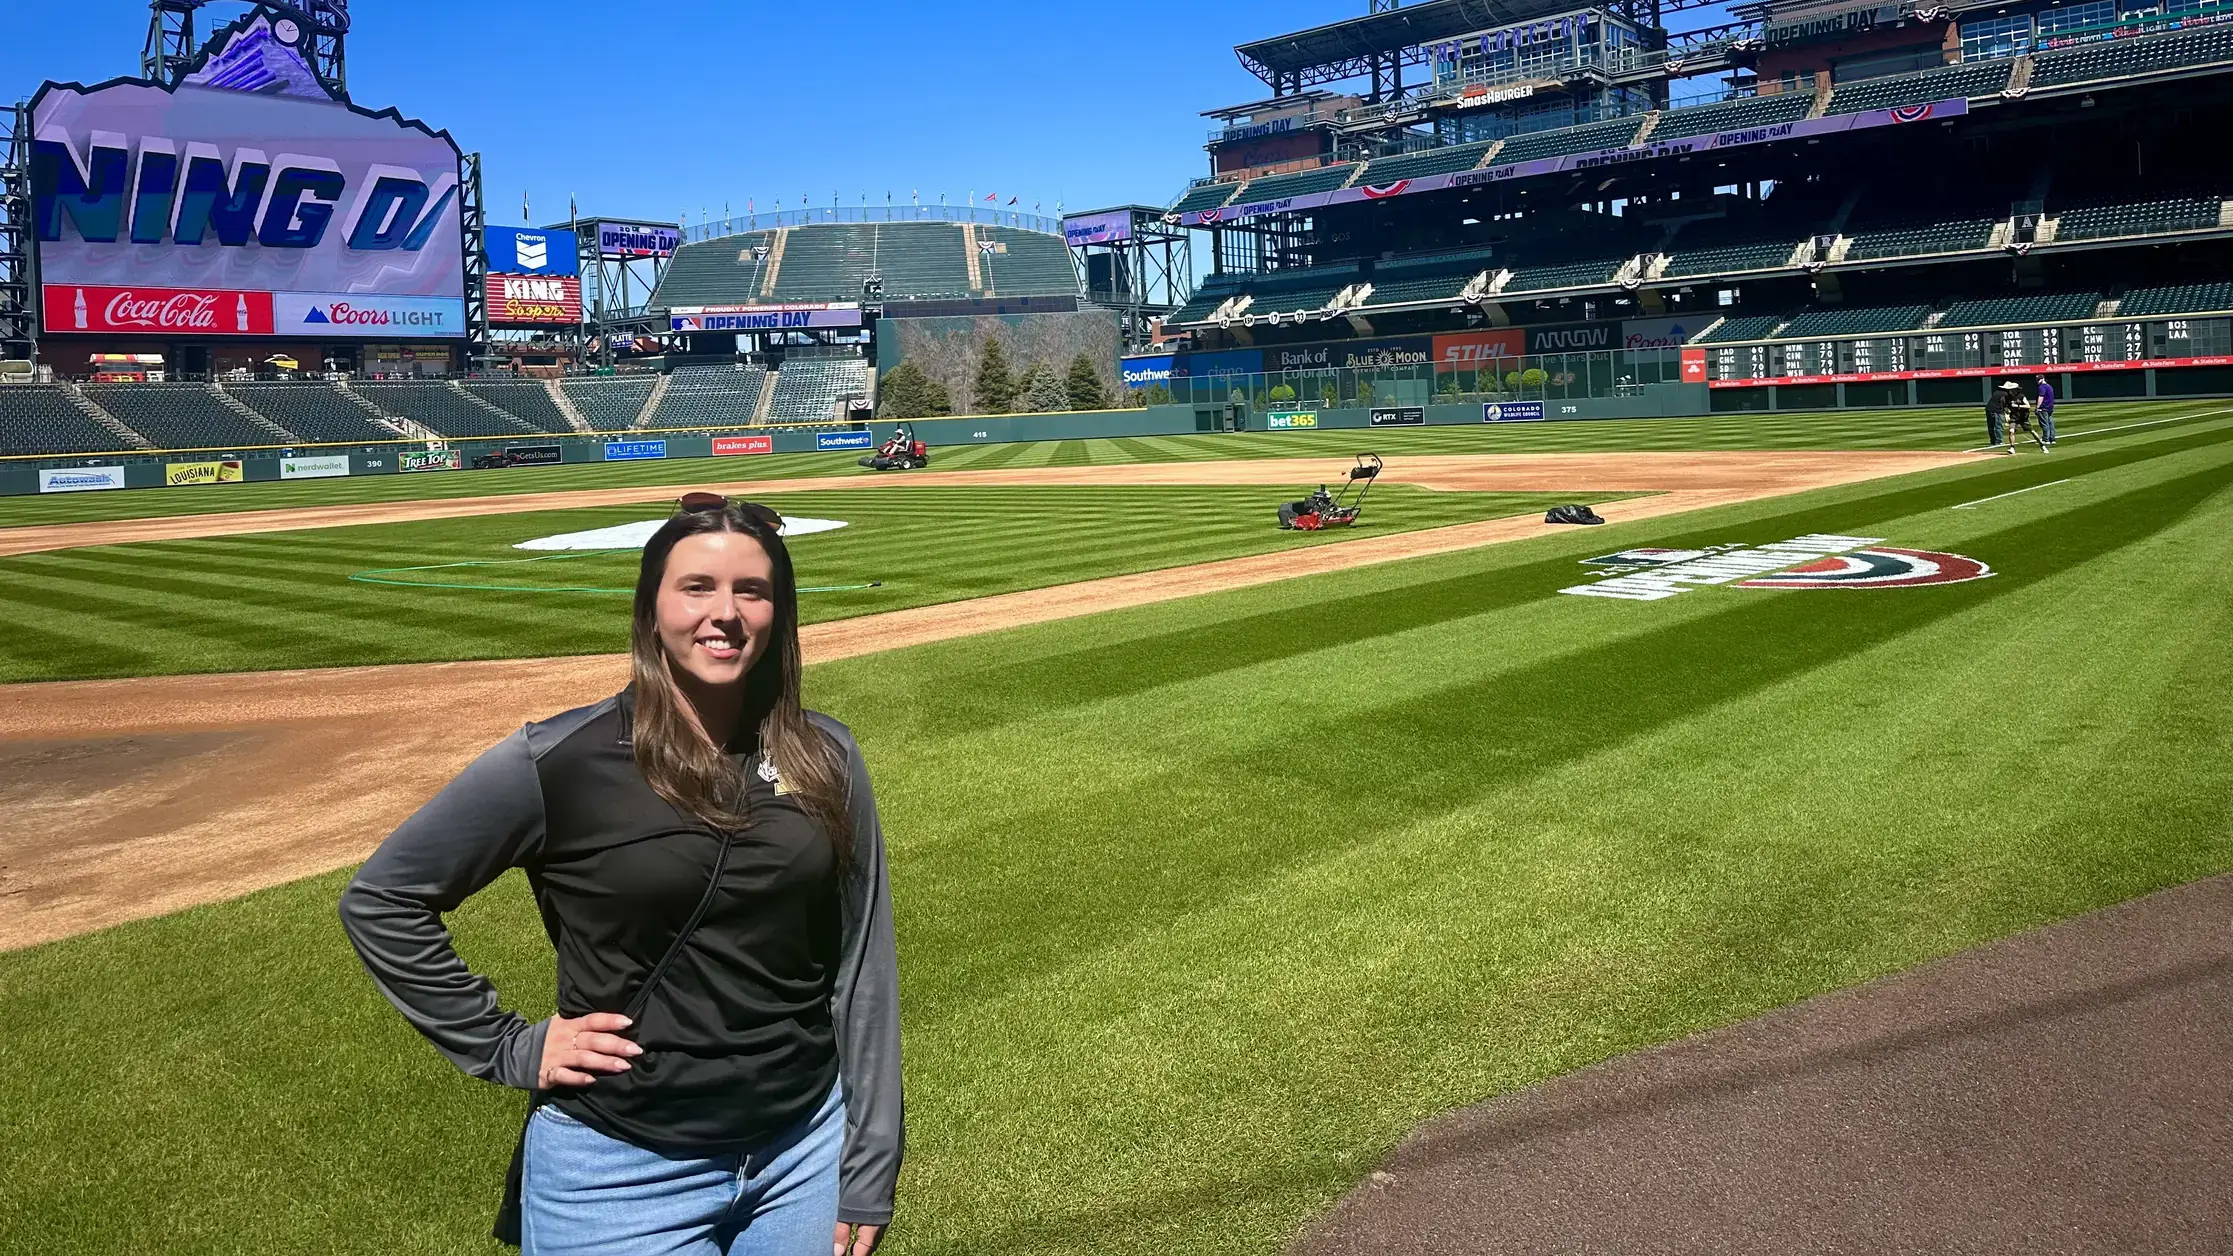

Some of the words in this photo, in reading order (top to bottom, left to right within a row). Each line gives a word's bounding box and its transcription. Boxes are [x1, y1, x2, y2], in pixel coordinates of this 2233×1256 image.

[1768, 16, 1843, 41] OPENING
[1847, 8, 1879, 29] DAY
[1480, 13, 1588, 54] ROOFTOP
[1224, 122, 1269, 141] OPENING
[1272, 118, 1291, 131] DAY
[1720, 129, 1766, 145] OPENING
[1456, 171, 1496, 186] OPENING
[1244, 202, 1274, 215] OPENING
[2021, 216, 2033, 228] A
[516, 233, 546, 241] Chevron
[1068, 228, 1092, 238] OPENING
[603, 232, 656, 250] OPENING
[658, 236, 680, 250] DAY
[504, 280, 564, 300] KING
[105, 292, 219, 327] Coca-Cola
[329, 303, 390, 325] Coors
[393, 311, 443, 326] LIGHT
[705, 313, 777, 329] OPENING
[782, 312, 811, 327] DAY
[2168, 320, 2187, 329] BOS
[612, 334, 632, 343] PLATTE
[1535, 328, 1608, 349] ARROW
[2003, 331, 2020, 339] TOR
[2084, 334, 2103, 343] CHW
[2169, 330, 2188, 339] LAA
[1626, 333, 1678, 351] Coors
[1927, 336, 1943, 344] SEA
[2003, 340, 2021, 348] NYY
[1445, 343, 1512, 360] STIHL
[1720, 348, 1734, 356] LAD
[1786, 344, 1802, 352] NYM
[1928, 344, 1944, 352] MIL
[2085, 345, 2102, 353] HOU
[1281, 349, 1312, 365] Bank
[1315, 348, 1328, 363] of
[1590, 352, 1608, 361] Out
[2003, 350, 2022, 358] OAK
[2085, 354, 2100, 362] TEX
[1346, 353, 1373, 367] BLUE
[1395, 352, 1427, 363] MOON
[1720, 356, 1735, 364] CHC
[2004, 359, 2019, 367] DET
[1123, 367, 1179, 382] Southwest
[1207, 365, 1244, 382] cigna
[1283, 362, 1340, 380] Colorado
[1858, 366, 1871, 374] PIT
[1720, 373, 1728, 381] SF
[1270, 415, 1315, 427] bet365
[749, 441, 767, 450] plus
[820, 437, 863, 446] Southwest
[617, 444, 663, 453] LIFETIME
[405, 457, 427, 468] TREE
[427, 454, 446, 465] TOP
[298, 463, 342, 472] nerdwallet
[48, 474, 110, 485] Autowash
[170, 467, 215, 484] LOUISIANA
